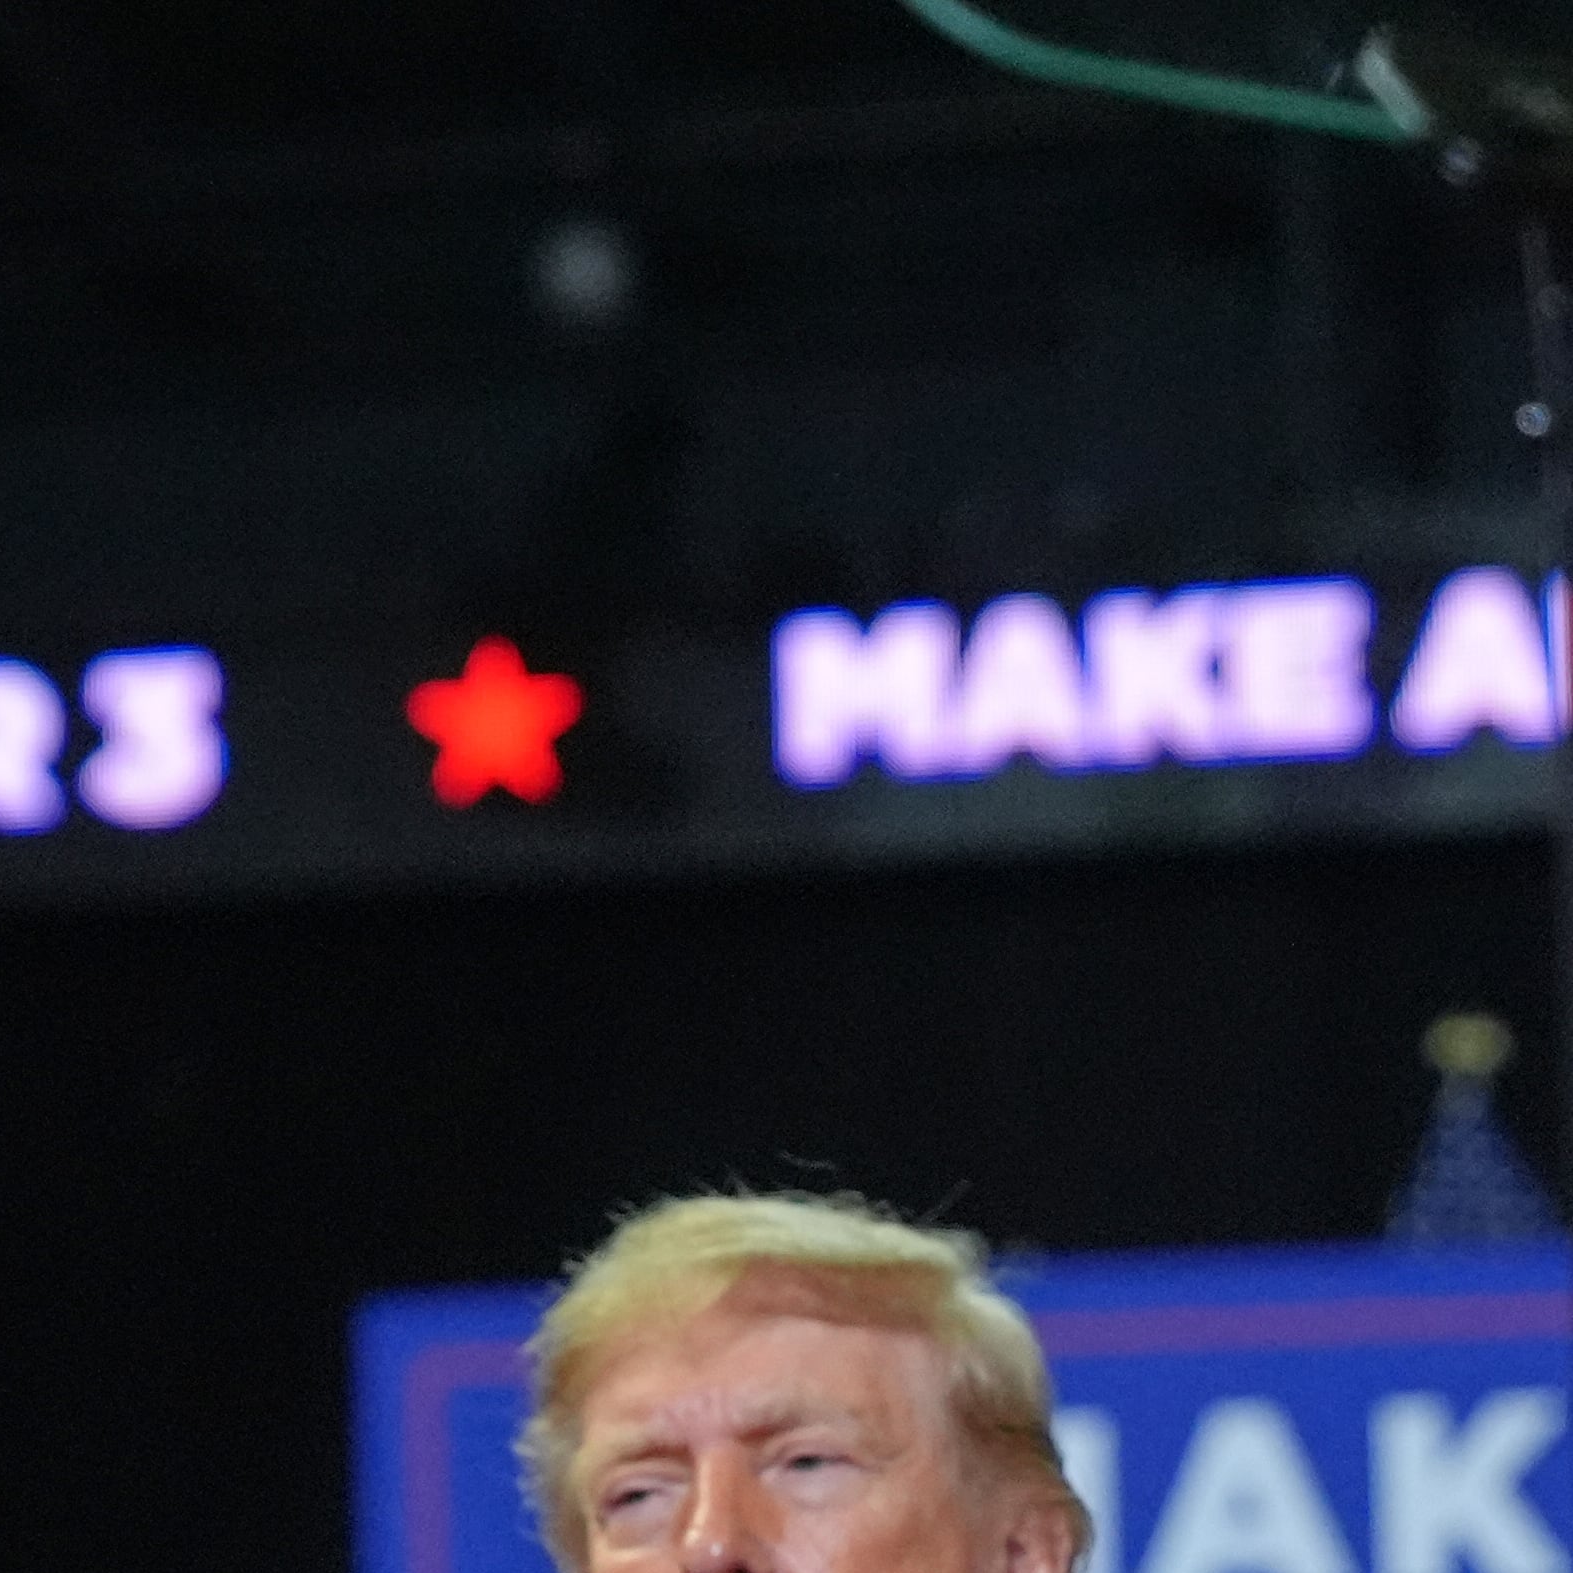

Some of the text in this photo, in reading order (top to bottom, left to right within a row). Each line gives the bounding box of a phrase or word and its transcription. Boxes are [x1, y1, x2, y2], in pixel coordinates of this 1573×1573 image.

[78, 644, 230, 830] 3
[771, 565, 1573, 790] MAKE A
